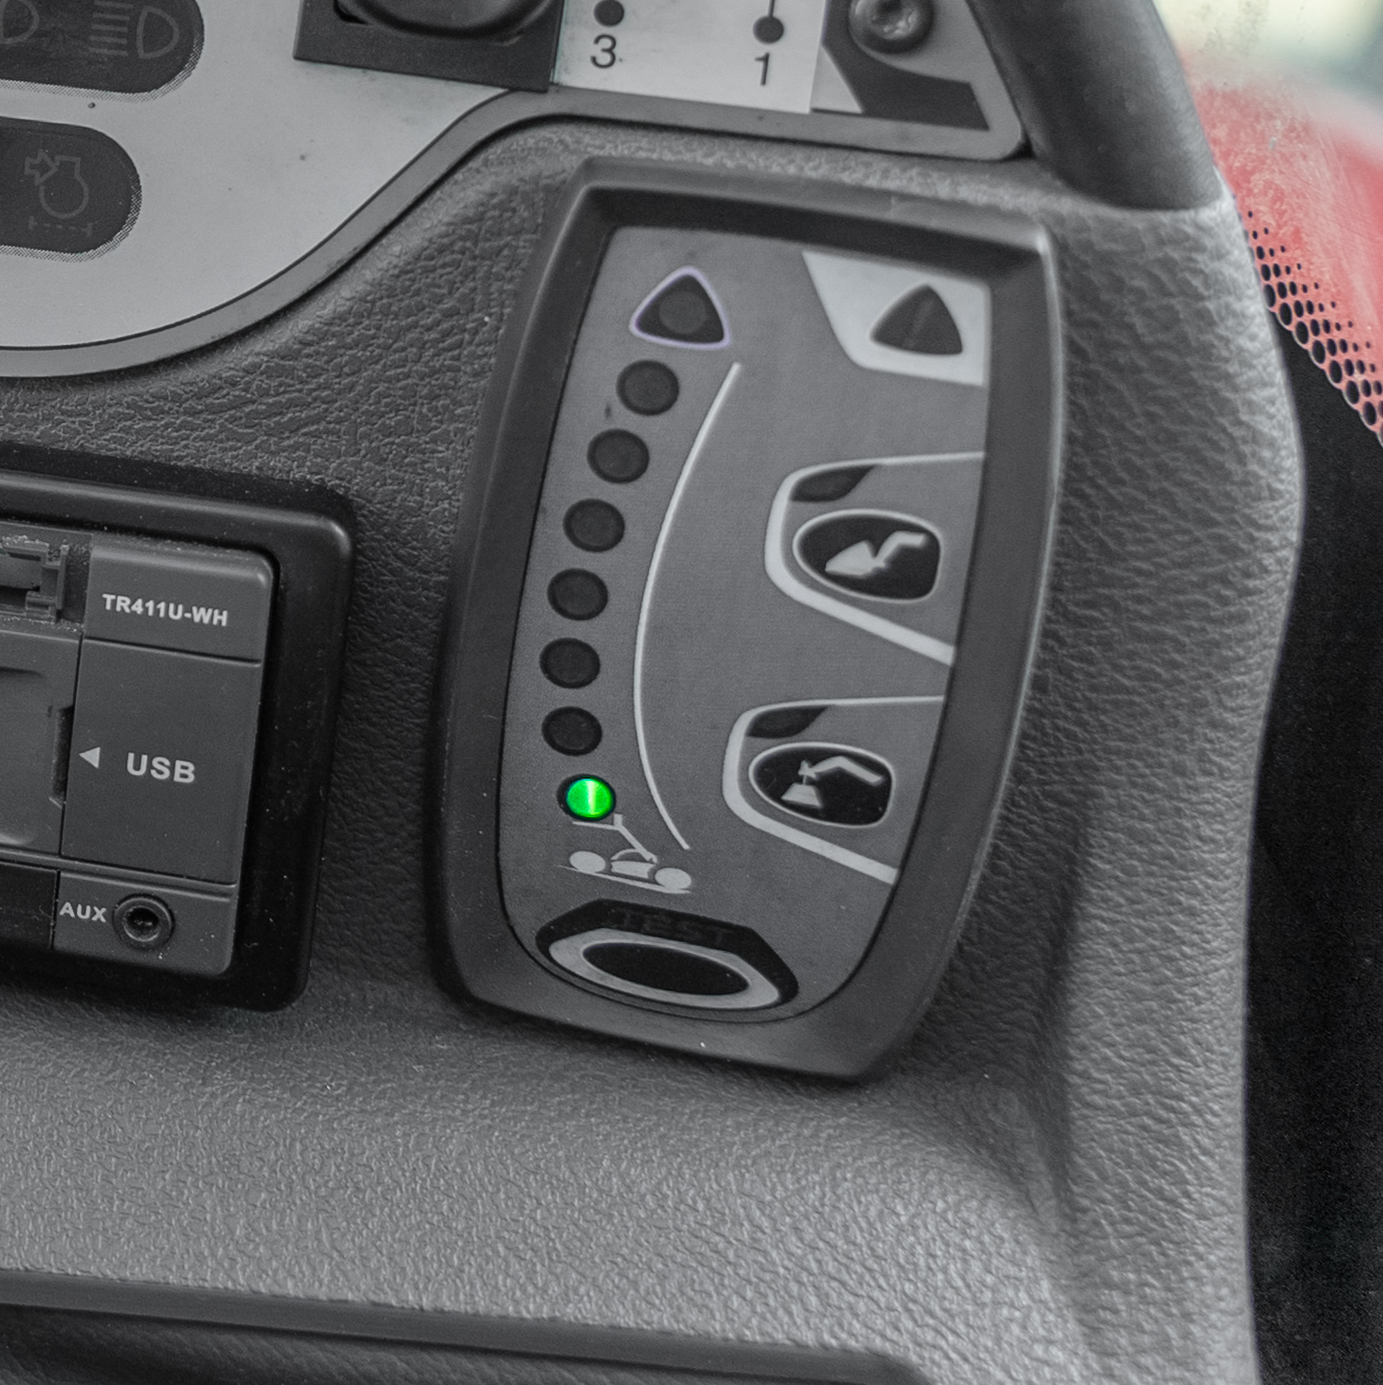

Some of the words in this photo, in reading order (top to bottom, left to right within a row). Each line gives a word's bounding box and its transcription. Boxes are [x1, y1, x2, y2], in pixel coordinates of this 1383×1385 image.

[590, 34, 618, 69] 3
[754, 52, 771, 87] 1
[102, 593, 228, 627] TR411U-WH
[126, 751, 196, 784] USB
[59, 900, 107, 923] AUX
